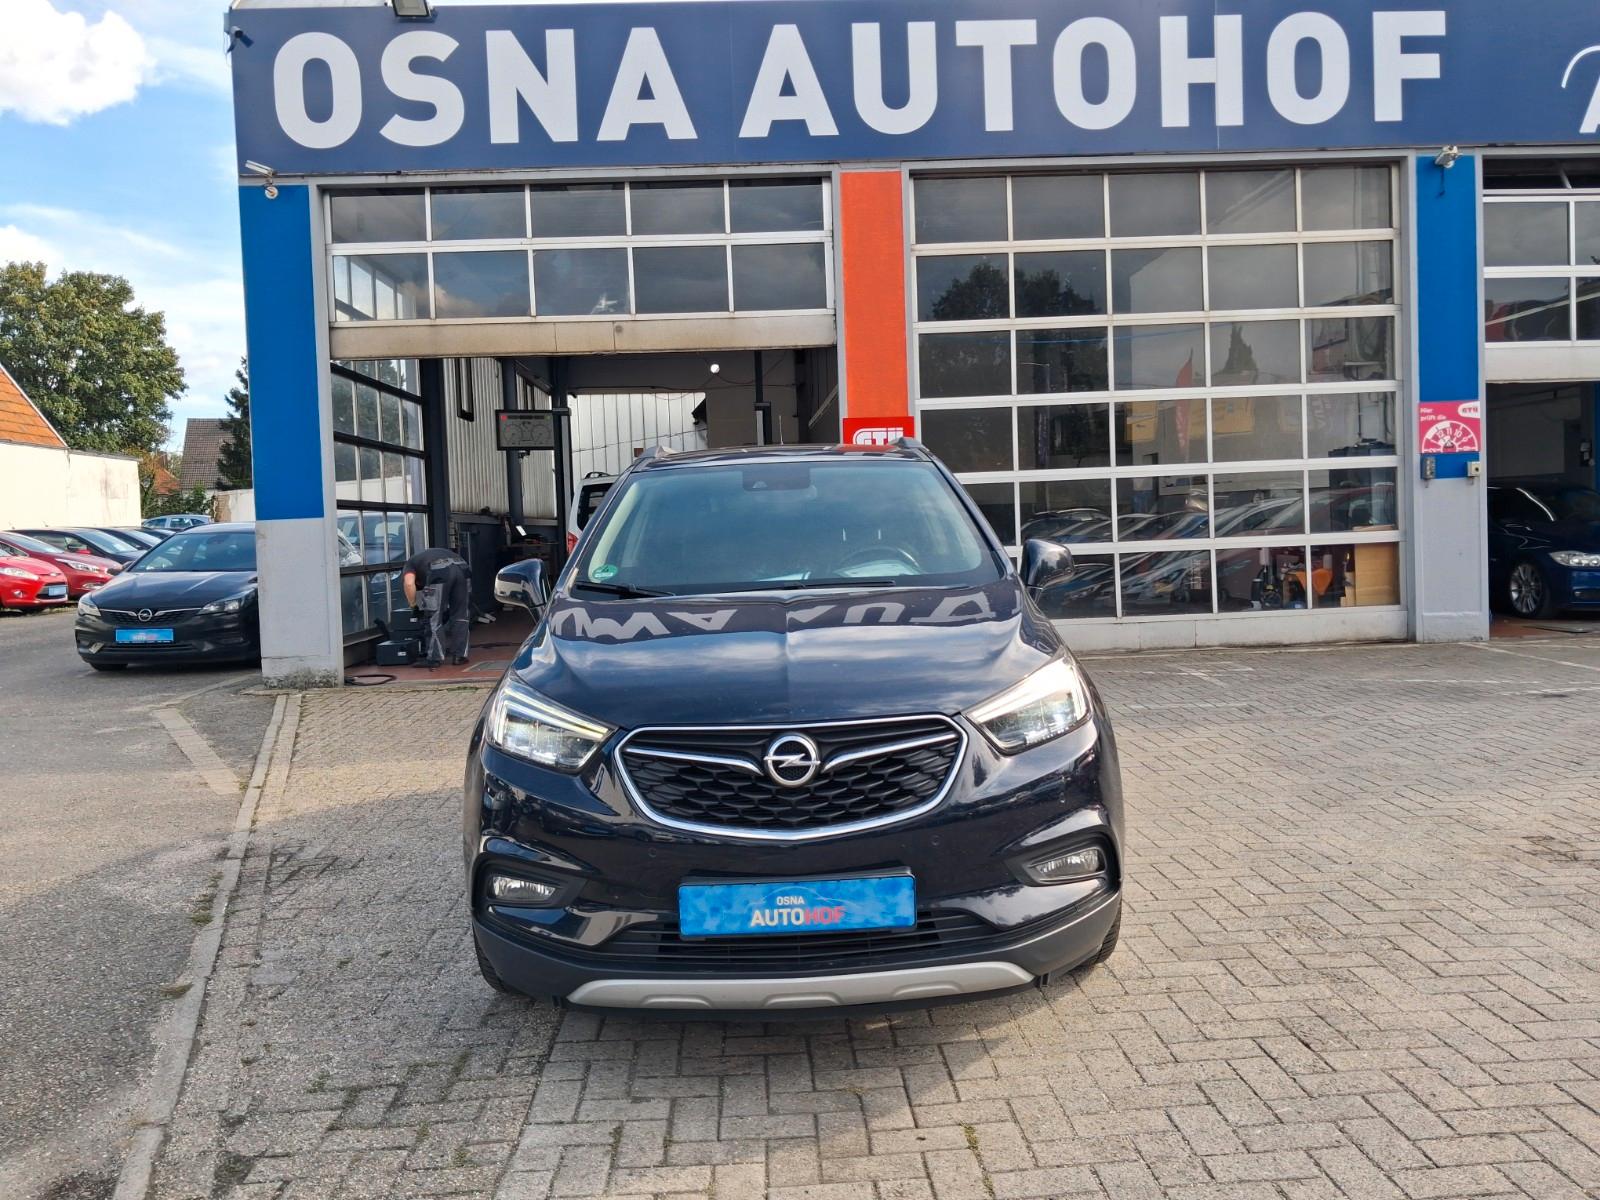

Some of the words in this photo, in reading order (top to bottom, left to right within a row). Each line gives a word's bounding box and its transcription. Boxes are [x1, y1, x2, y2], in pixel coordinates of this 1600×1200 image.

[274, 28, 697, 148] OSNA
[739, 11, 1445, 137] AUTOHOF
[776, 896, 805, 905] OSNA
[750, 906, 845, 927] AUTOHOF
